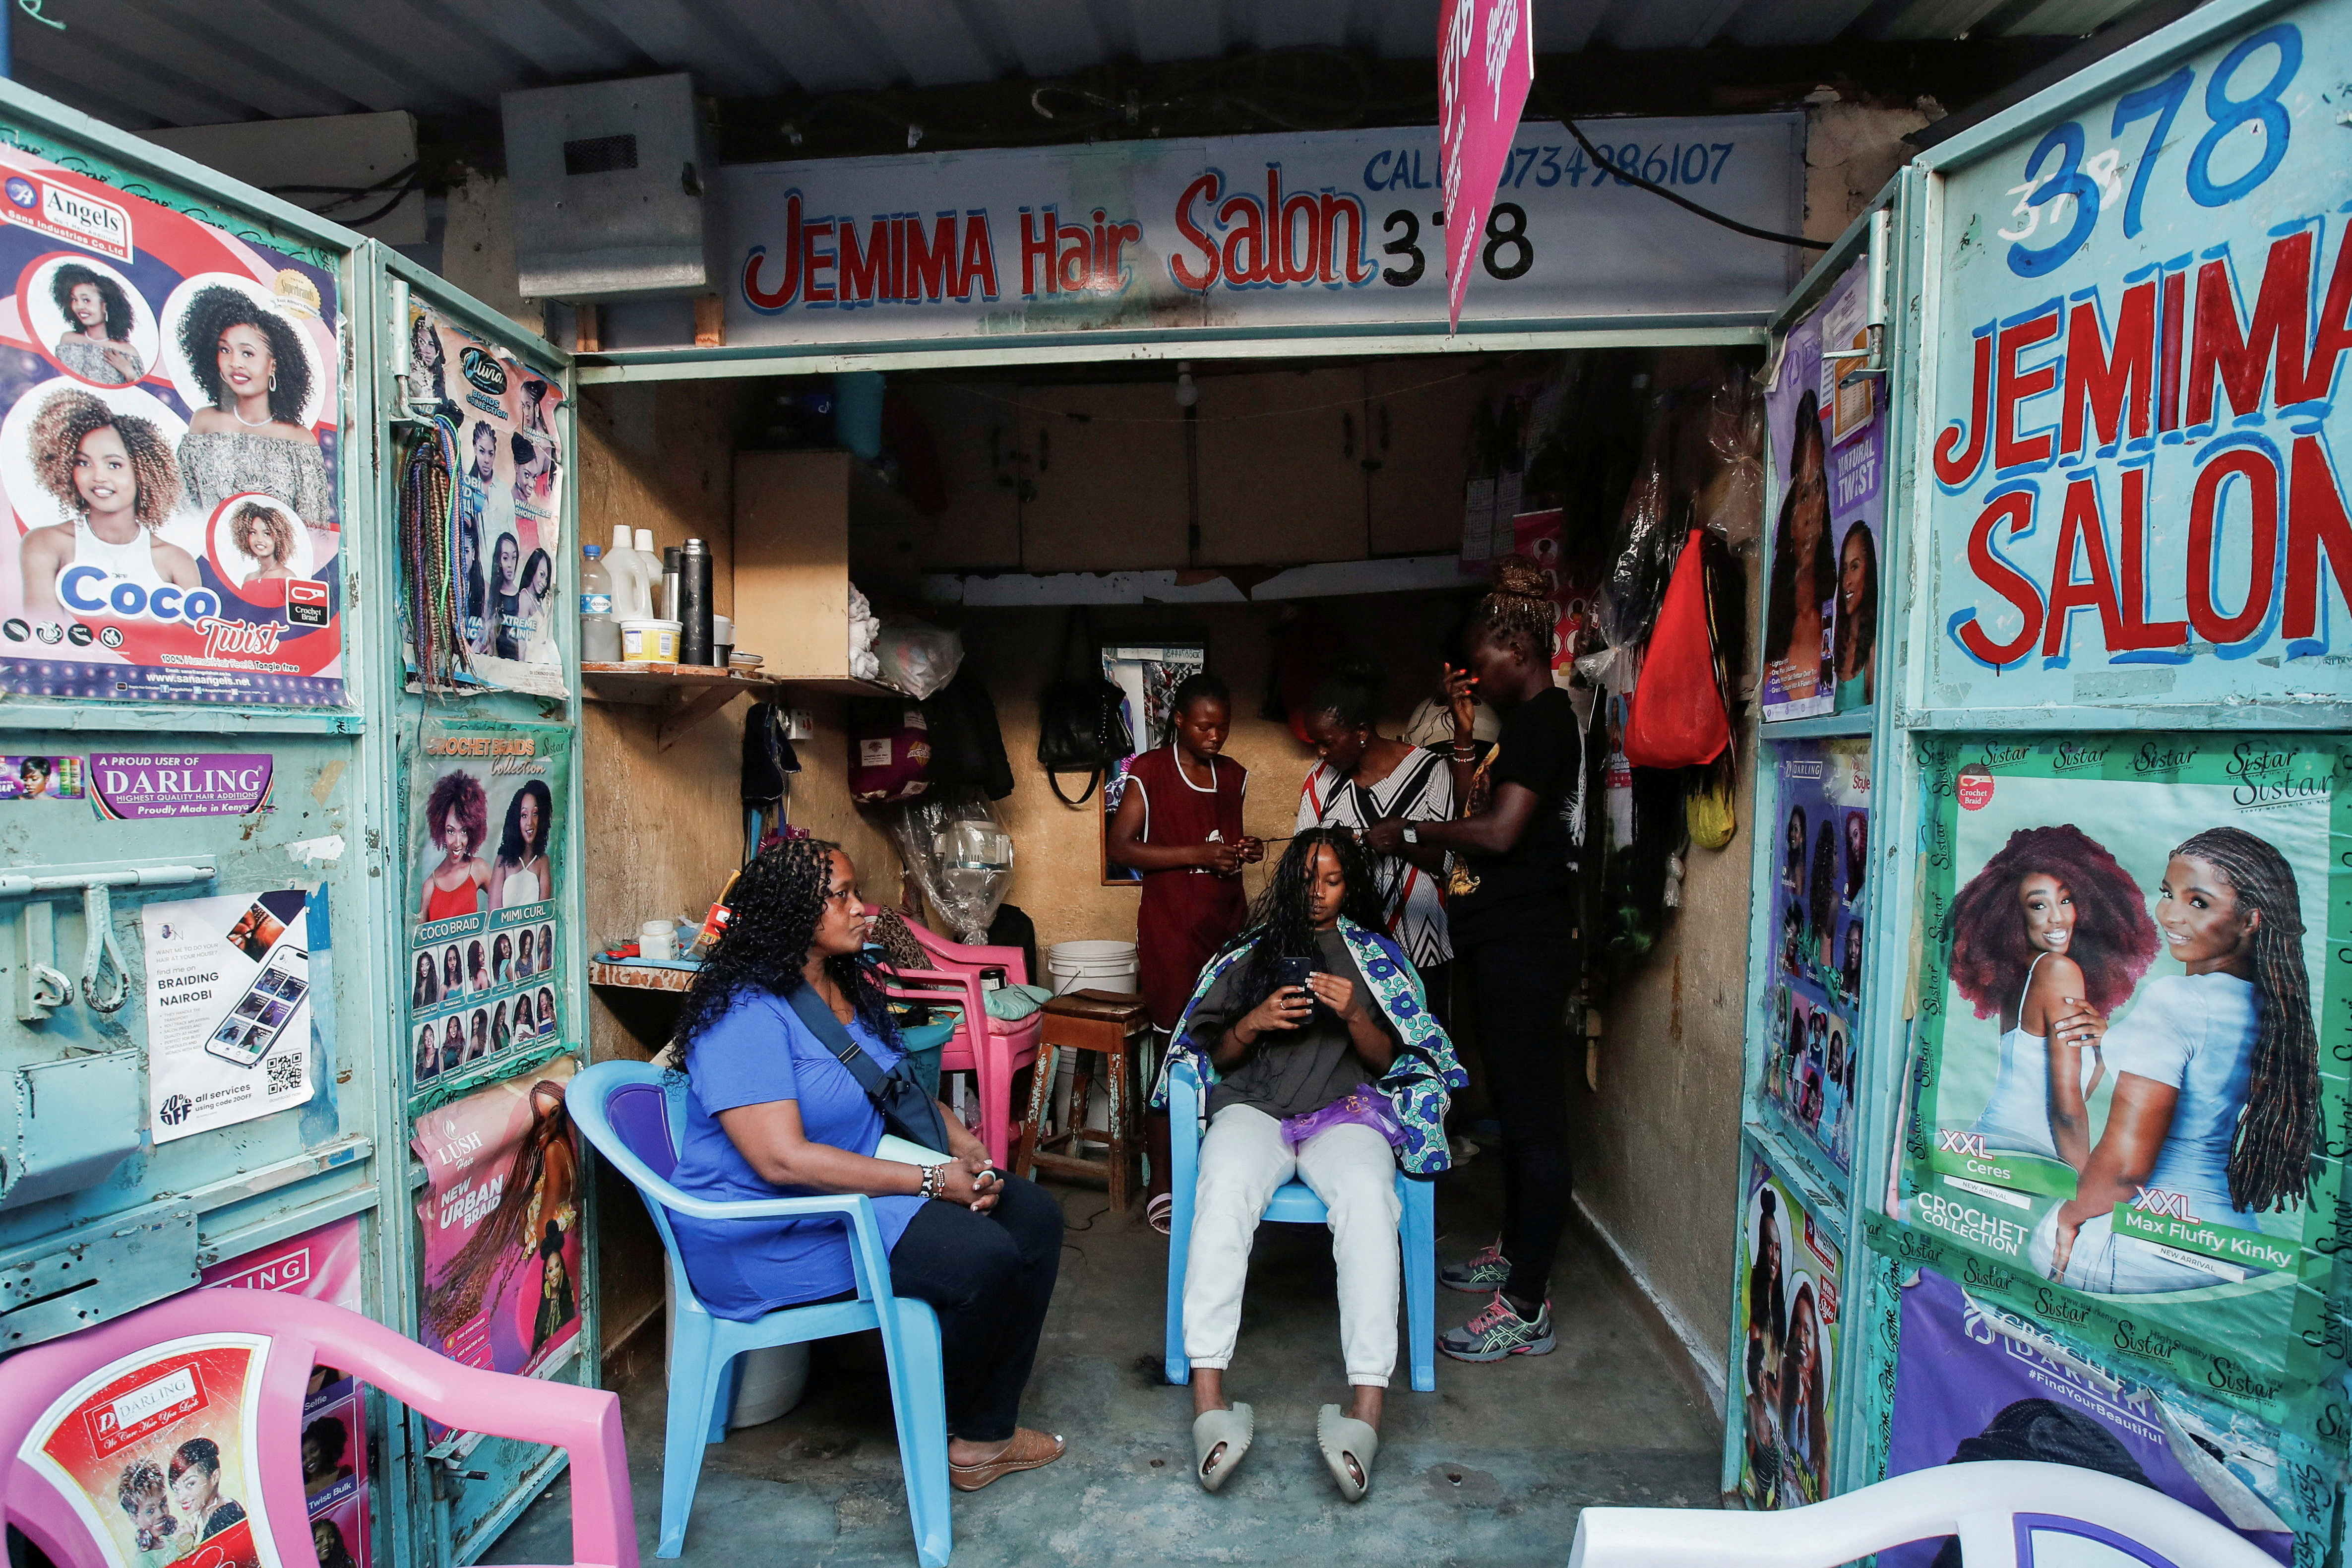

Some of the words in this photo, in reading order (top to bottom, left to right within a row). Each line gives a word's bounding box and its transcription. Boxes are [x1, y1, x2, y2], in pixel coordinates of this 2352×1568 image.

[2007, 22, 2303, 278] 378
[1447, 158, 1461, 230] SALON
[47, 190, 119, 231] Angels
[8, 210, 34, 225] Sana
[38, 219, 88, 244] Industries
[92, 239, 106, 250] Co.
[109, 245, 123, 255] Ltd
[88, 229, 120, 244] Additions
[742, 189, 999, 313] JEMIMA
[1019, 204, 1141, 298] Hair
[1170, 165, 1377, 293] Salon
[1383, 202, 1534, 287] 38
[281, 279, 314, 301] Superbrands
[465, 350, 503, 384] Olivia
[466, 395, 508, 420] COLLECTION
[472, 390, 500, 408] BRAIDS
[523, 425, 557, 443] RWANDESE
[524, 433, 541, 444] LONG
[1838, 437, 1875, 478] NATURAL
[1838, 459, 1875, 508] TWIST
[515, 499, 552, 518] RWANDESE
[515, 506, 535, 521] SHORT
[1949, 432, 2352, 667] SALON
[62, 566, 215, 620] Coco
[295, 606, 321, 617] Crochet
[301, 613, 318, 622] Braid
[502, 614, 538, 630] XTREME
[195, 616, 289, 658] Twist
[161, 654, 183, 664] 100%
[186, 655, 212, 666] Human
[212, 657, 230, 668] Hair
[230, 659, 248, 669] Feel
[255, 661, 280, 672] Tangle
[283, 663, 300, 673] free
[146, 673, 251, 686] www.sanaangels.net
[428, 738, 491, 756] CROCHET
[493, 738, 535, 756] BRAIDS
[543, 736, 565, 757] Sistar
[1981, 741, 2030, 767] Sistar
[2053, 741, 2108, 769] Sistar
[2134, 742, 2196, 772] Sistar
[2226, 743, 2297, 775] Sistar
[112, 757, 151, 766] PROUD
[154, 757, 181, 766] USER
[184, 757, 199, 766] OF
[491, 755, 545, 775] Collection
[1794, 762, 1821, 776] DARLING
[104, 769, 261, 795] DARLING
[1853, 774, 1870, 793] Style
[1960, 788, 1987, 797] Crochet
[2233, 762, 2333, 805] Sistar
[137, 804, 177, 815] Proudly
[179, 804, 207, 814] Made
[222, 803, 249, 813] Kenya
[156, 793, 193, 802] QUALITY
[217, 791, 258, 800] ADDITIONS
[1930, 821, 1950, 870] Sistar
[500, 909, 523, 924] MIMI
[524, 905, 546, 920] CURL
[1928, 893, 1945, 944] Sistar
[421, 924, 448, 941] COCO
[449, 918, 479, 938] BRAID
[158, 972, 219, 989] BRAIDING
[1922, 965, 1939, 1015] Sistar
[160, 990, 212, 1006] NAIROBI
[160, 1094, 192, 1115] 20%
[195, 1104, 214, 1112] using
[216, 1098, 232, 1107] code
[196, 1093, 207, 1103] all
[210, 1084, 250, 1099] services
[269, 1095, 290, 1103] download
[161, 1103, 192, 1125] OFF
[436, 1130, 483, 1167] LUSH
[1939, 1129, 1994, 1161] XXL
[456, 1155, 474, 1172] Hair
[1967, 1158, 2010, 1180] Ceres
[439, 1174, 504, 1230] URBAN
[441, 1175, 473, 1208] NEW
[1962, 1181, 1980, 1192] NEW
[1981, 1185, 2008, 1201] ARRIVAL
[463, 1193, 501, 1231] BRAID
[1918, 1192, 2029, 1245] CROCHET
[2133, 1186, 2201, 1225] XXL
[1922, 1210, 2018, 1256] COLLECTION
[2126, 1210, 2164, 1234] Max
[2169, 1217, 2226, 1253] Fluffy
[2230, 1237, 2293, 1269] Kinky
[1899, 1232, 1942, 1261] Sistar
[2160, 1247, 2179, 1259] NEW
[2180, 1251, 2216, 1273] ARRIVAL
[1883, 1258, 1899, 1303] SISTAR
[1964, 1258, 2012, 1290] Sistar
[1822, 1278, 1835, 1299] With
[1819, 1298, 1834, 1321] Styles
[2035, 1287, 2089, 1323] Sistar
[457, 1317, 485, 1340] PRE-STRETCHED
[1879, 1309, 1900, 1353] SISTAR
[2114, 1319, 2177, 1359] Sistar
[2150, 1330, 2172, 1345] High
[465, 1340, 478, 1353] WATER
[1878, 1360, 1895, 1405] SISTAR
[2208, 1357, 2280, 1399] Sistar
[120, 1379, 186, 1417] DARLING
[305, 1394, 327, 1411] Selfie
[2029, 1369, 2163, 1445] #FindYourBeautiful
[104, 1439, 118, 1449] We
[118, 1431, 137, 1442] Care
[159, 1411, 177, 1424] You
[179, 1398, 198, 1412] Look
[309, 1494, 331, 1509] Twist
[335, 1483, 352, 1498] Bulk
